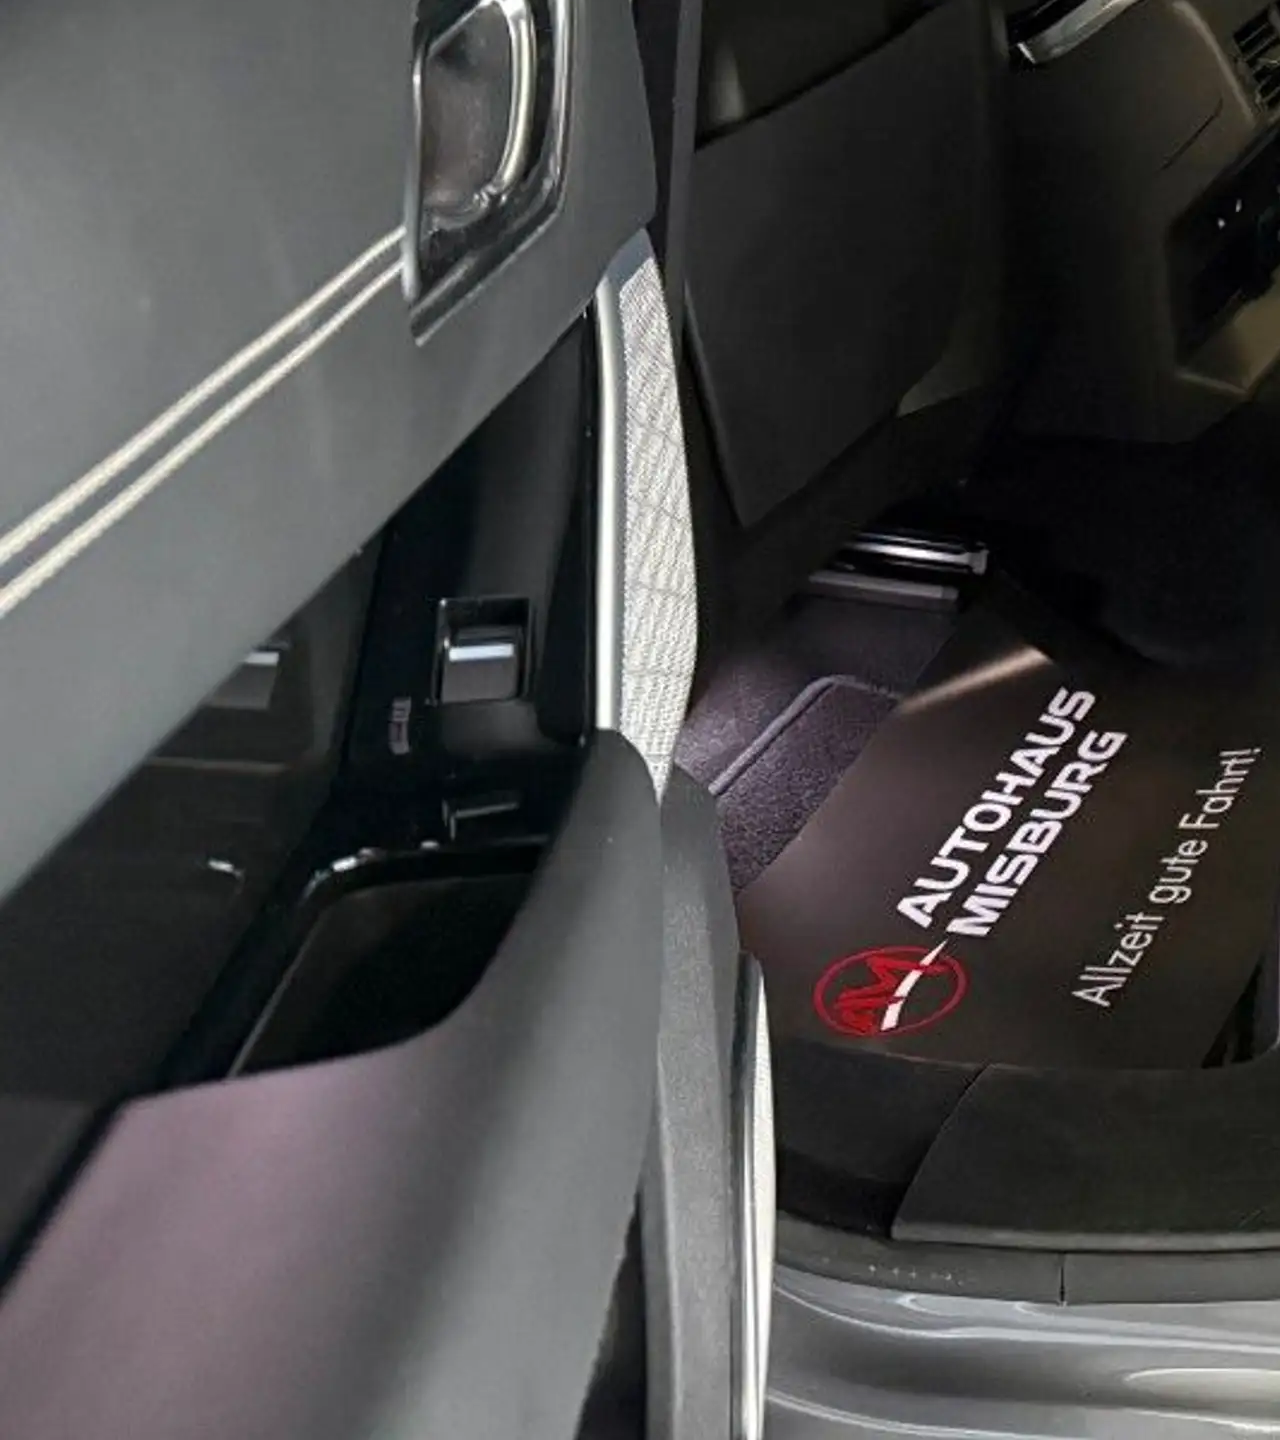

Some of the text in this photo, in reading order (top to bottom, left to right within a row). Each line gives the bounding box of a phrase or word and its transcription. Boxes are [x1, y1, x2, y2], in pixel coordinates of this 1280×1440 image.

[896, 687, 1096, 928] AUTOHAUS
[946, 730, 1127, 937] MISBURG
[1071, 747, 1263, 1008] Allzeit gute Fahrt!
